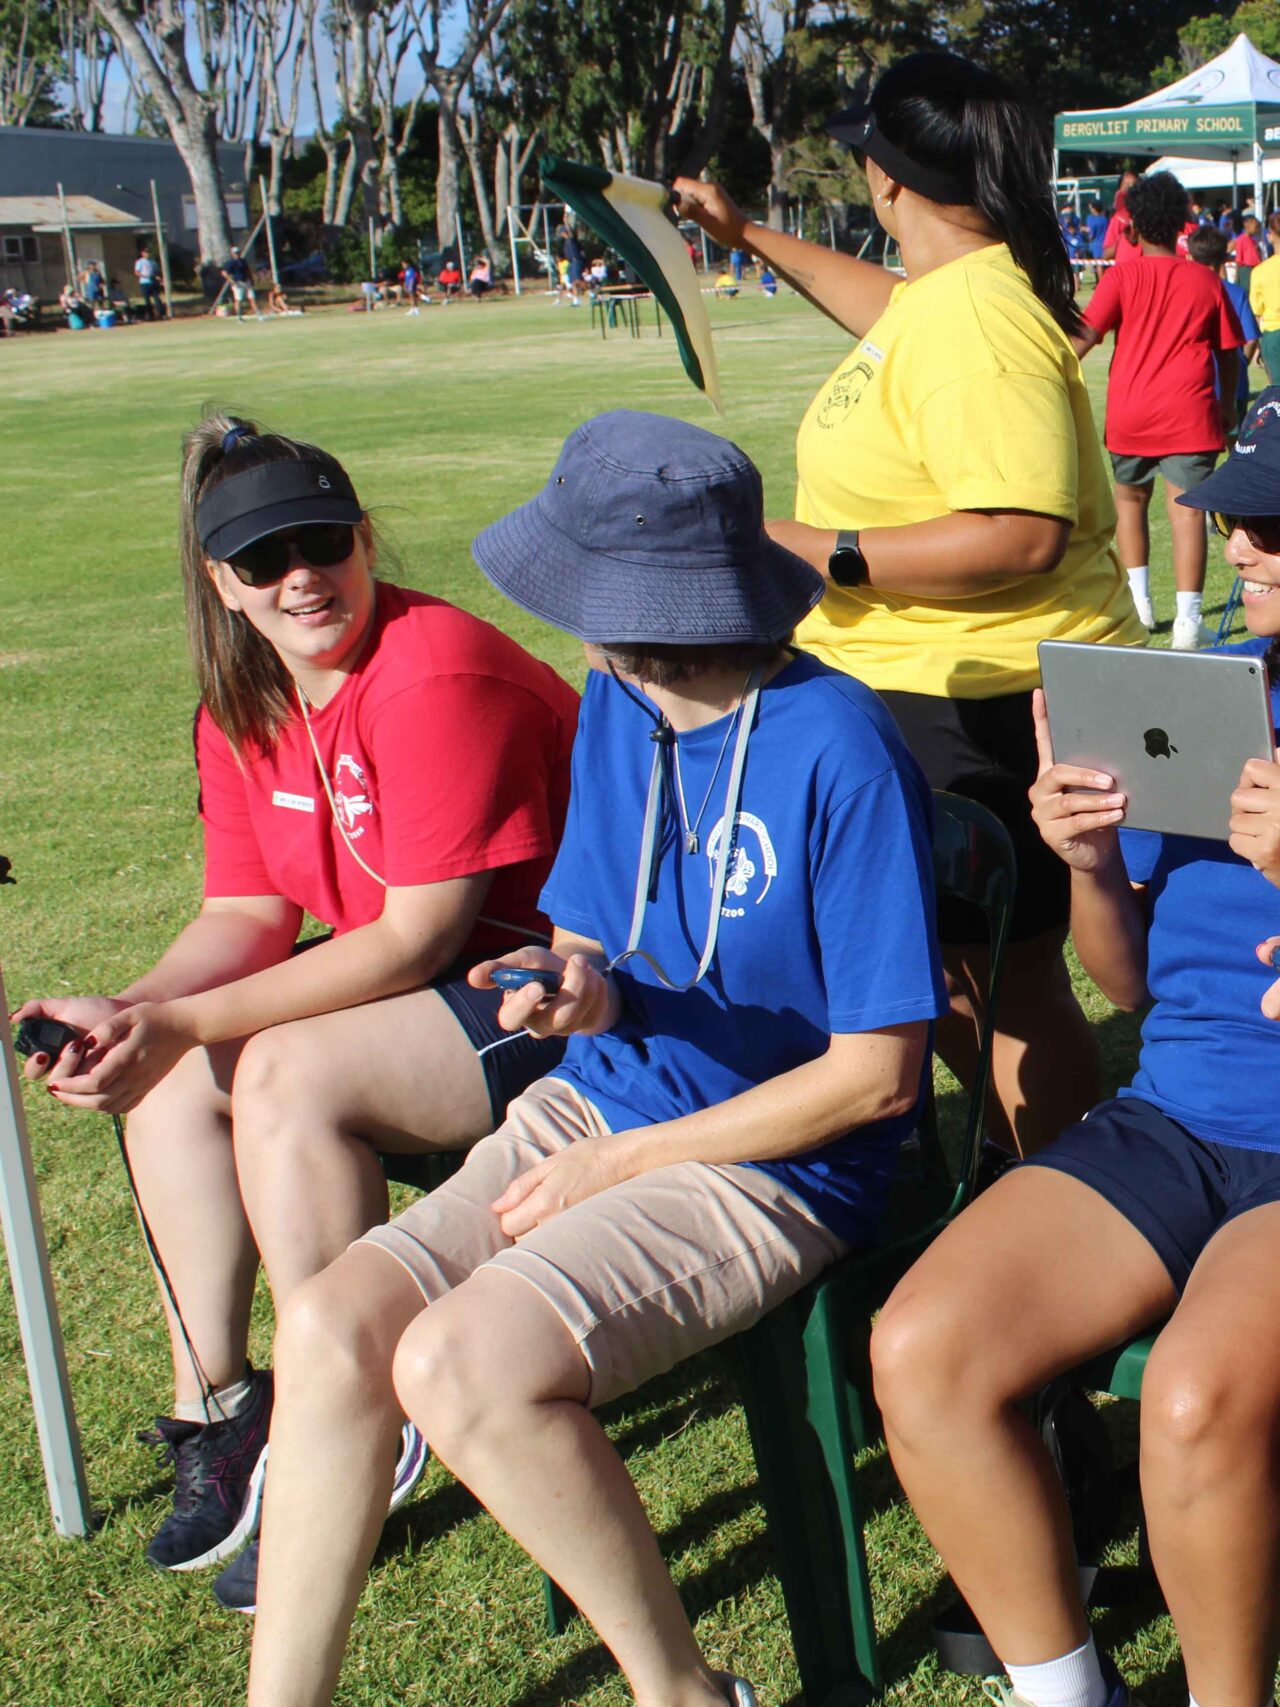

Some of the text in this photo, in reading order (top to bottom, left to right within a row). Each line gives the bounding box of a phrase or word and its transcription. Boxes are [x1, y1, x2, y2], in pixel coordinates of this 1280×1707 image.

[1063, 117, 1243, 137] BERGVLIET PRIMARY SCHOOL
